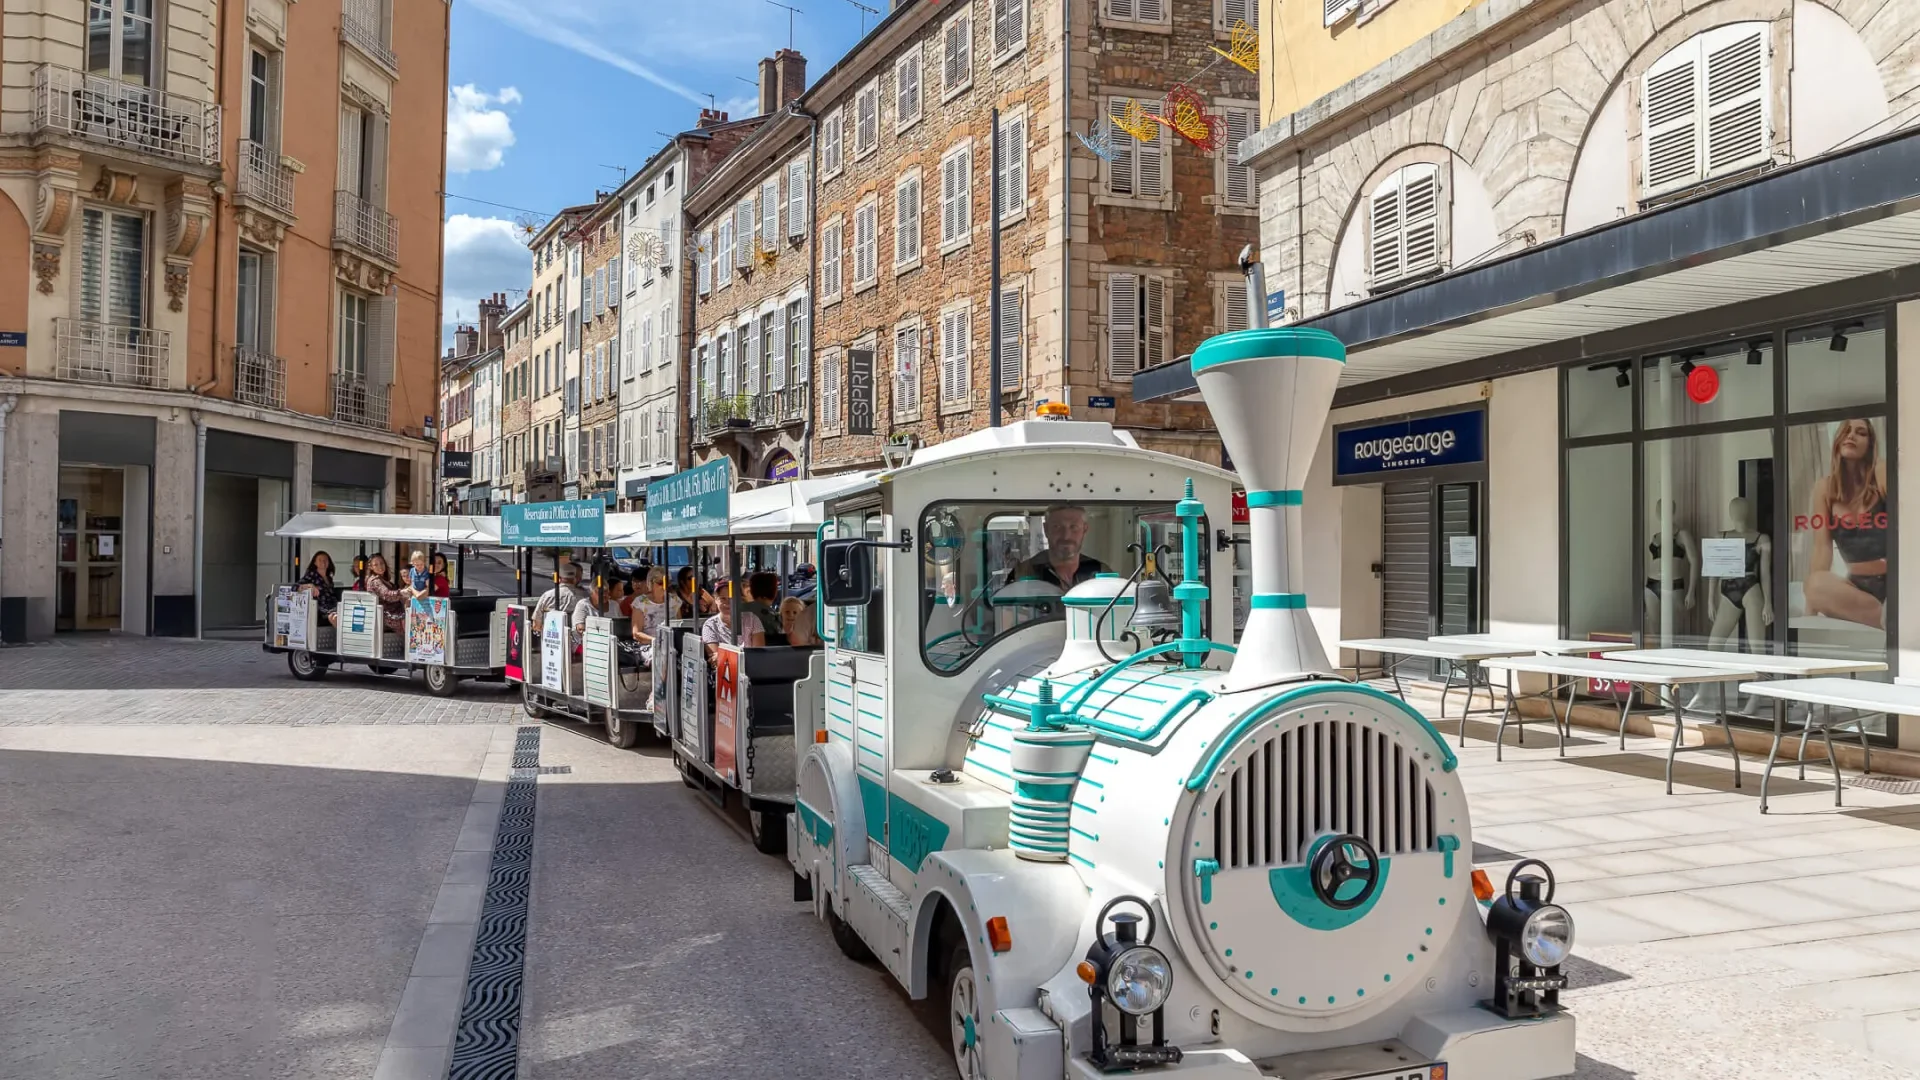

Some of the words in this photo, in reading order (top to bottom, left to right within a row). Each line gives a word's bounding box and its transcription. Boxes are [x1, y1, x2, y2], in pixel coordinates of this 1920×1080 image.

[851, 356, 869, 429] ESPRIT
[1382, 457, 1426, 468] LINGERIE
[524, 507, 549, 520] Réservation
[570, 503, 577, 519] de
[577, 503, 600, 519] Tourisme
[1794, 511, 1889, 531] ROUGEG
